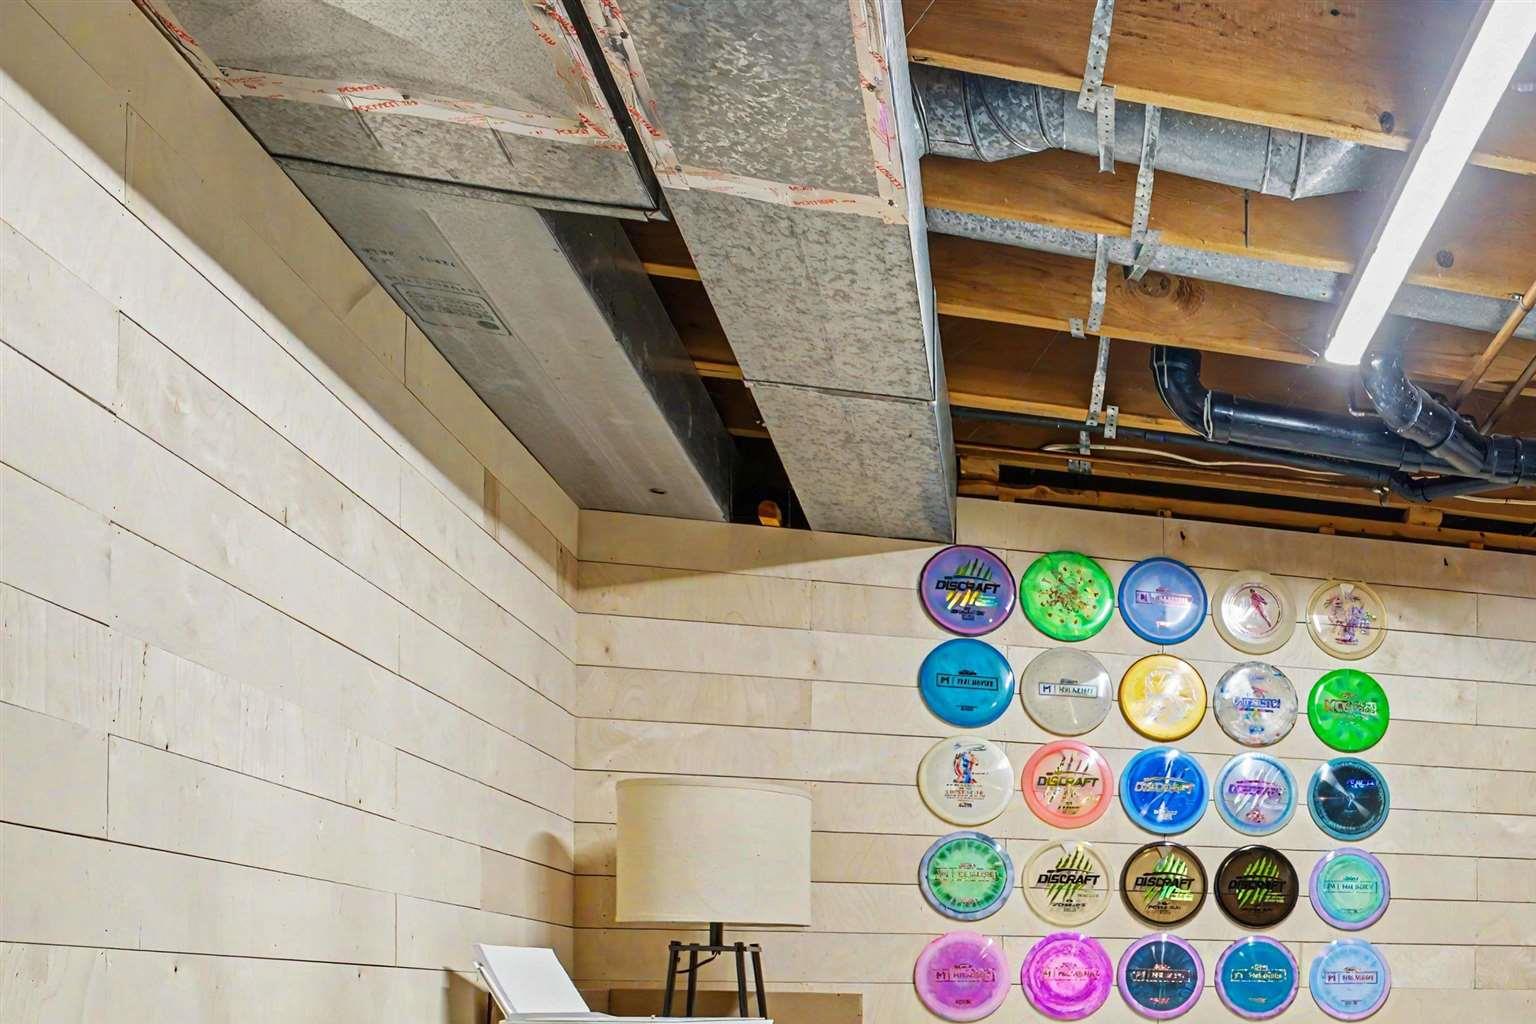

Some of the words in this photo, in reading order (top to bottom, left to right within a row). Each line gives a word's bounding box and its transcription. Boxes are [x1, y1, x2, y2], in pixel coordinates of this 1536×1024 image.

[935, 579, 1001, 595] DISCRAFT
[1037, 775, 1099, 789] DISCRAFT
[1037, 874, 1101, 886] DISCRAFT
[1135, 876, 1195, 890] DISCRAFT
[1228, 879, 1287, 892] DISCRAFT
